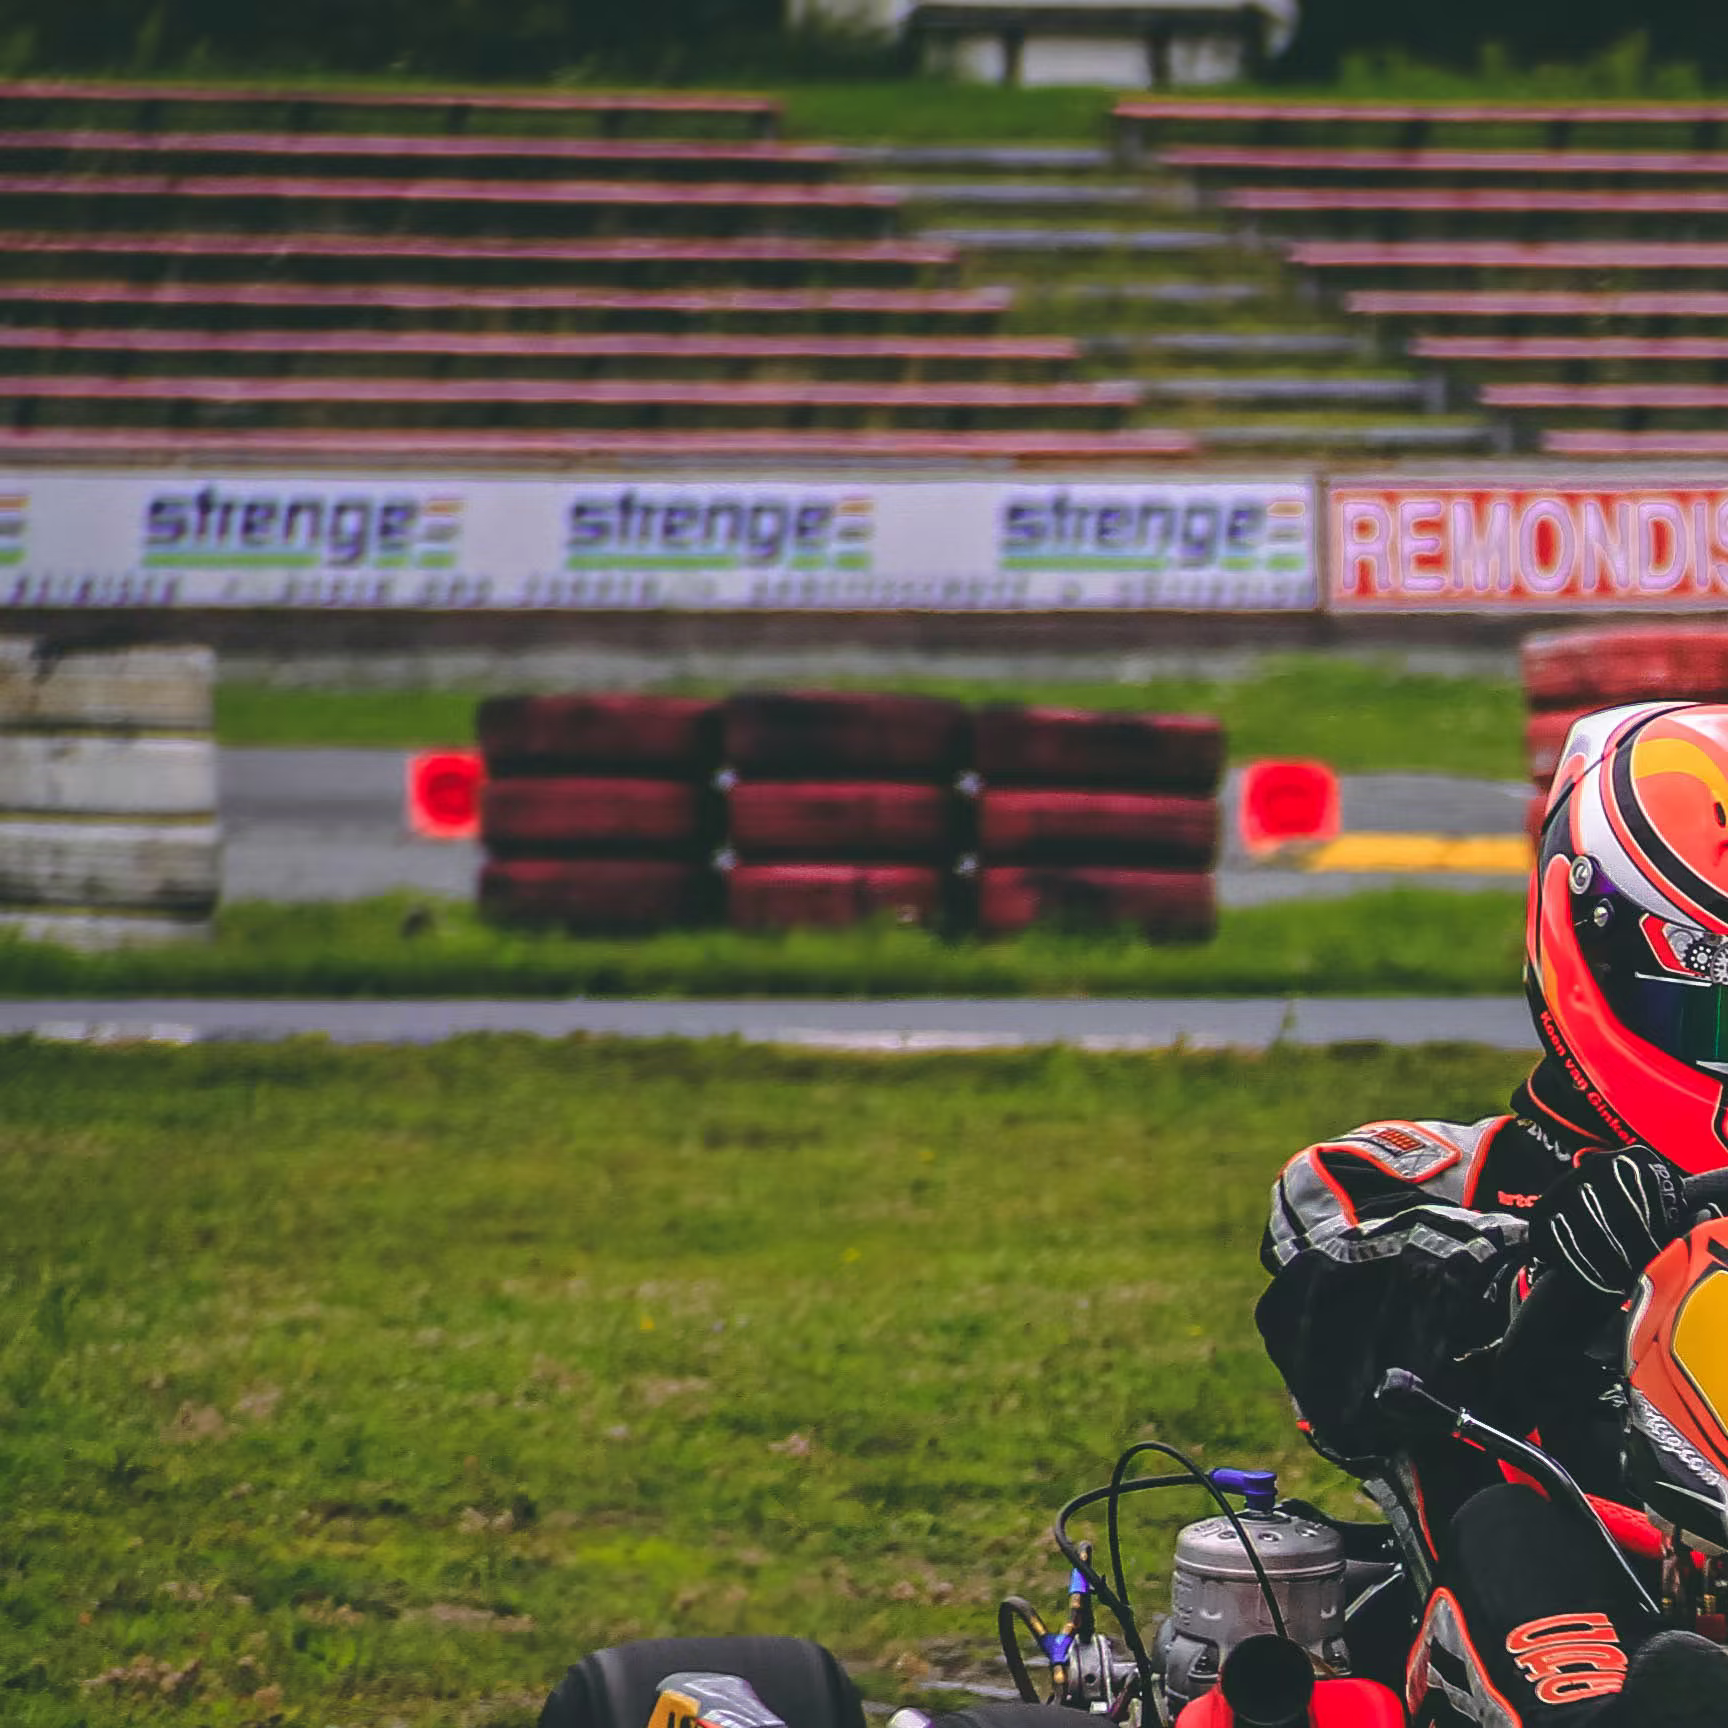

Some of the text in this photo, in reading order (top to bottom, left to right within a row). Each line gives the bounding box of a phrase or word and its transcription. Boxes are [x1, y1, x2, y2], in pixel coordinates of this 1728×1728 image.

[148, 490, 417, 568] strenge
[568, 490, 835, 567] strenge
[1003, 495, 1265, 567] strenge
